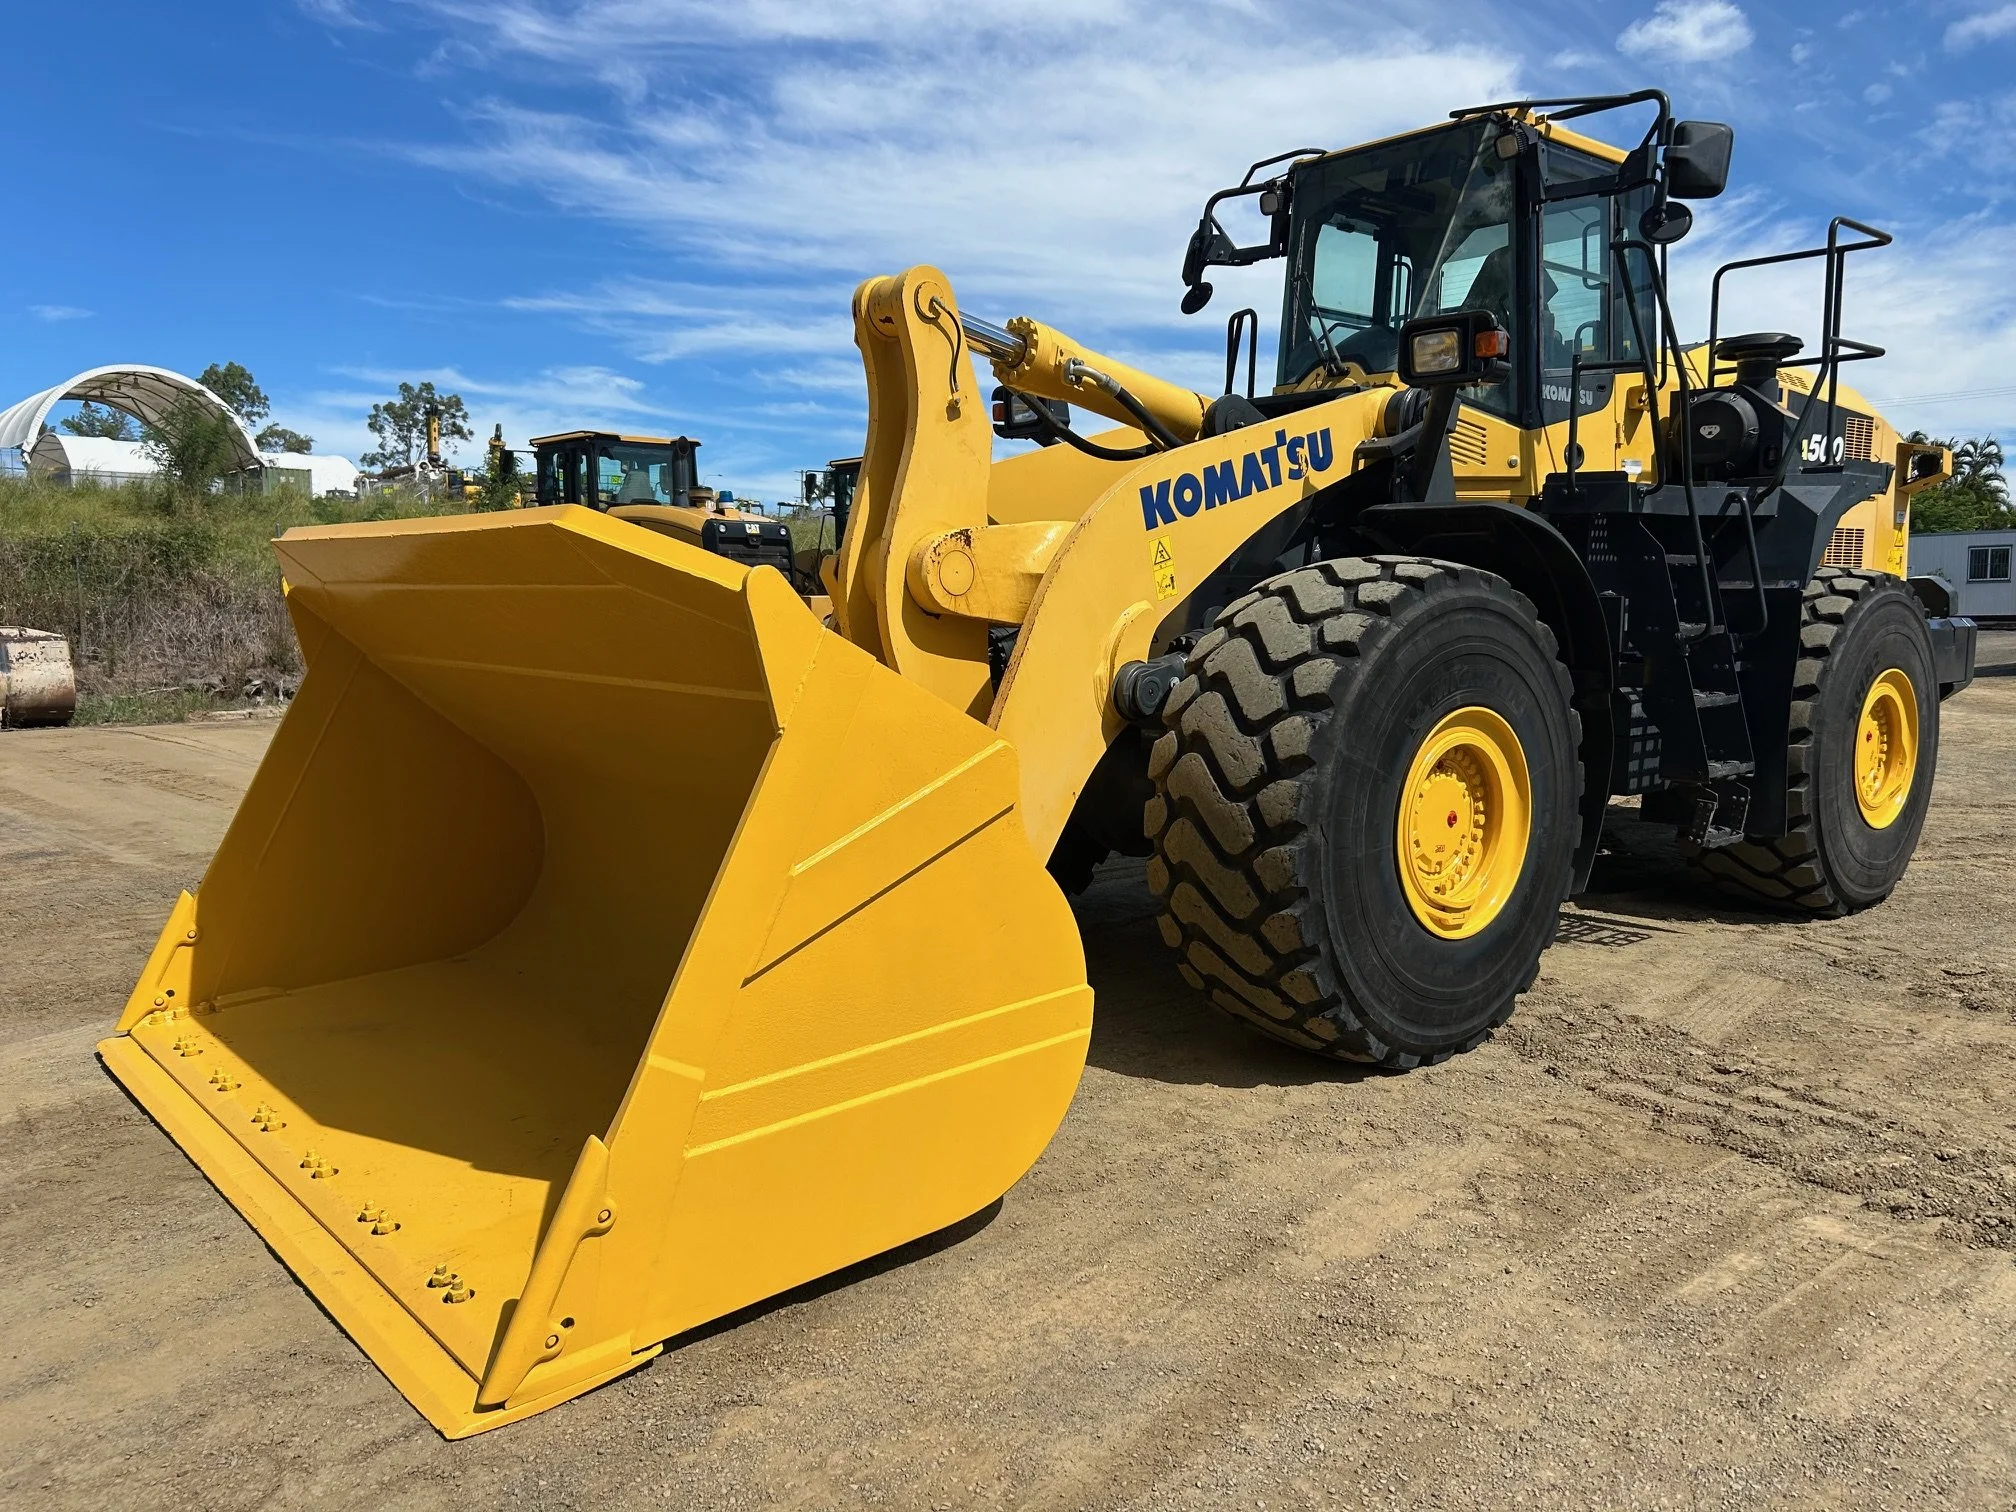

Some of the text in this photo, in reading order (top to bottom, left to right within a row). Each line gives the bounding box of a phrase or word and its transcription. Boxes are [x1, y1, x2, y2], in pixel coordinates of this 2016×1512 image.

[1541, 384, 1593, 406] KOMASU
[1139, 427, 1333, 531] KOMATSU
[745, 523, 760, 534] CAT
